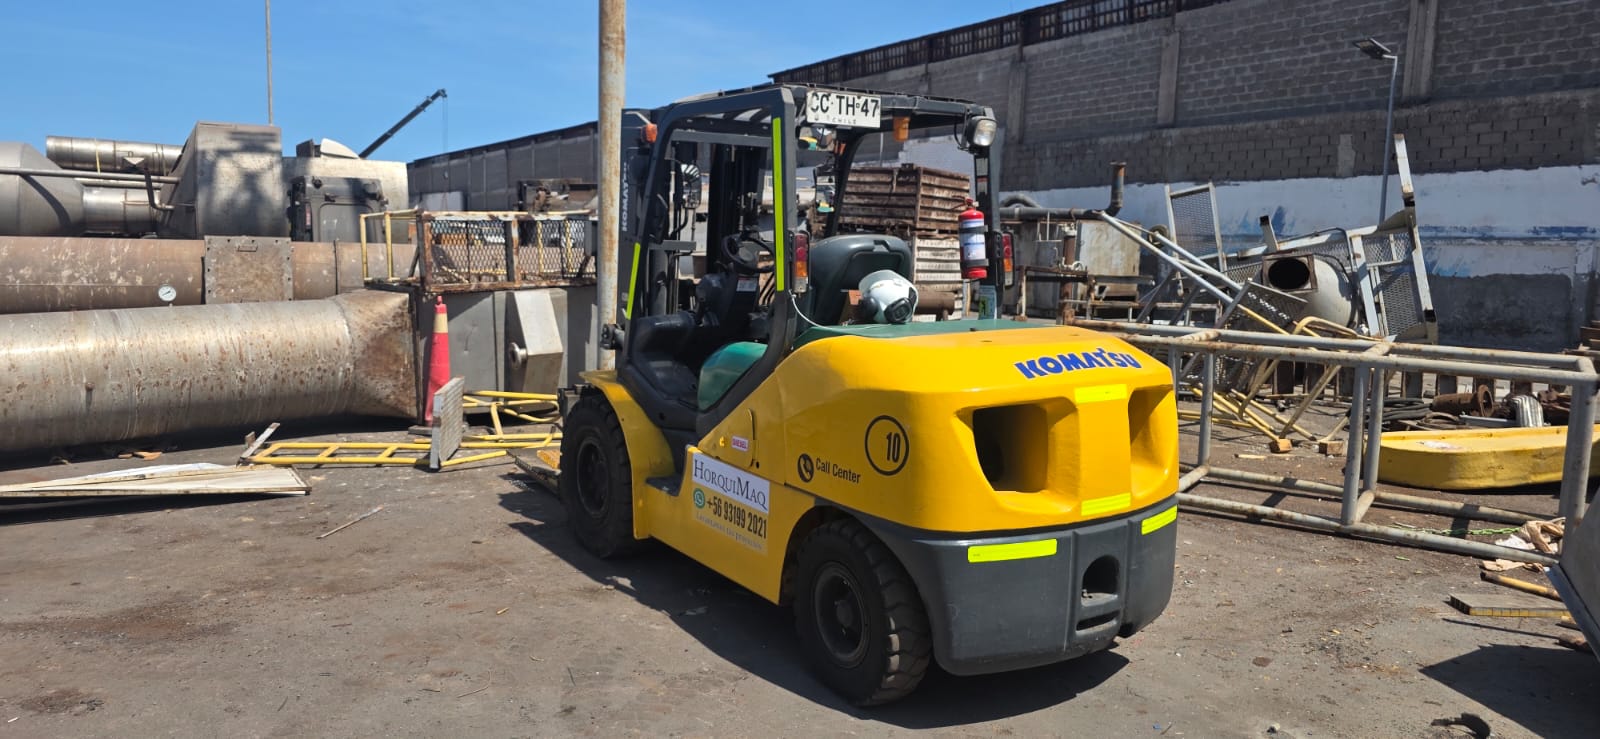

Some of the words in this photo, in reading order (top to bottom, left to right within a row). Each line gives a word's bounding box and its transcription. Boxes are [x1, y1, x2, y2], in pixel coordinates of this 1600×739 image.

[1014, 347, 1142, 379] KOMATSU
[886, 431, 901, 463] 10
[816, 457, 830, 474] Call
[832, 464, 862, 484] Center
[707, 496, 722, 518] +56
[723, 498, 746, 529] 93199
[747, 512, 767, 540] 2021
